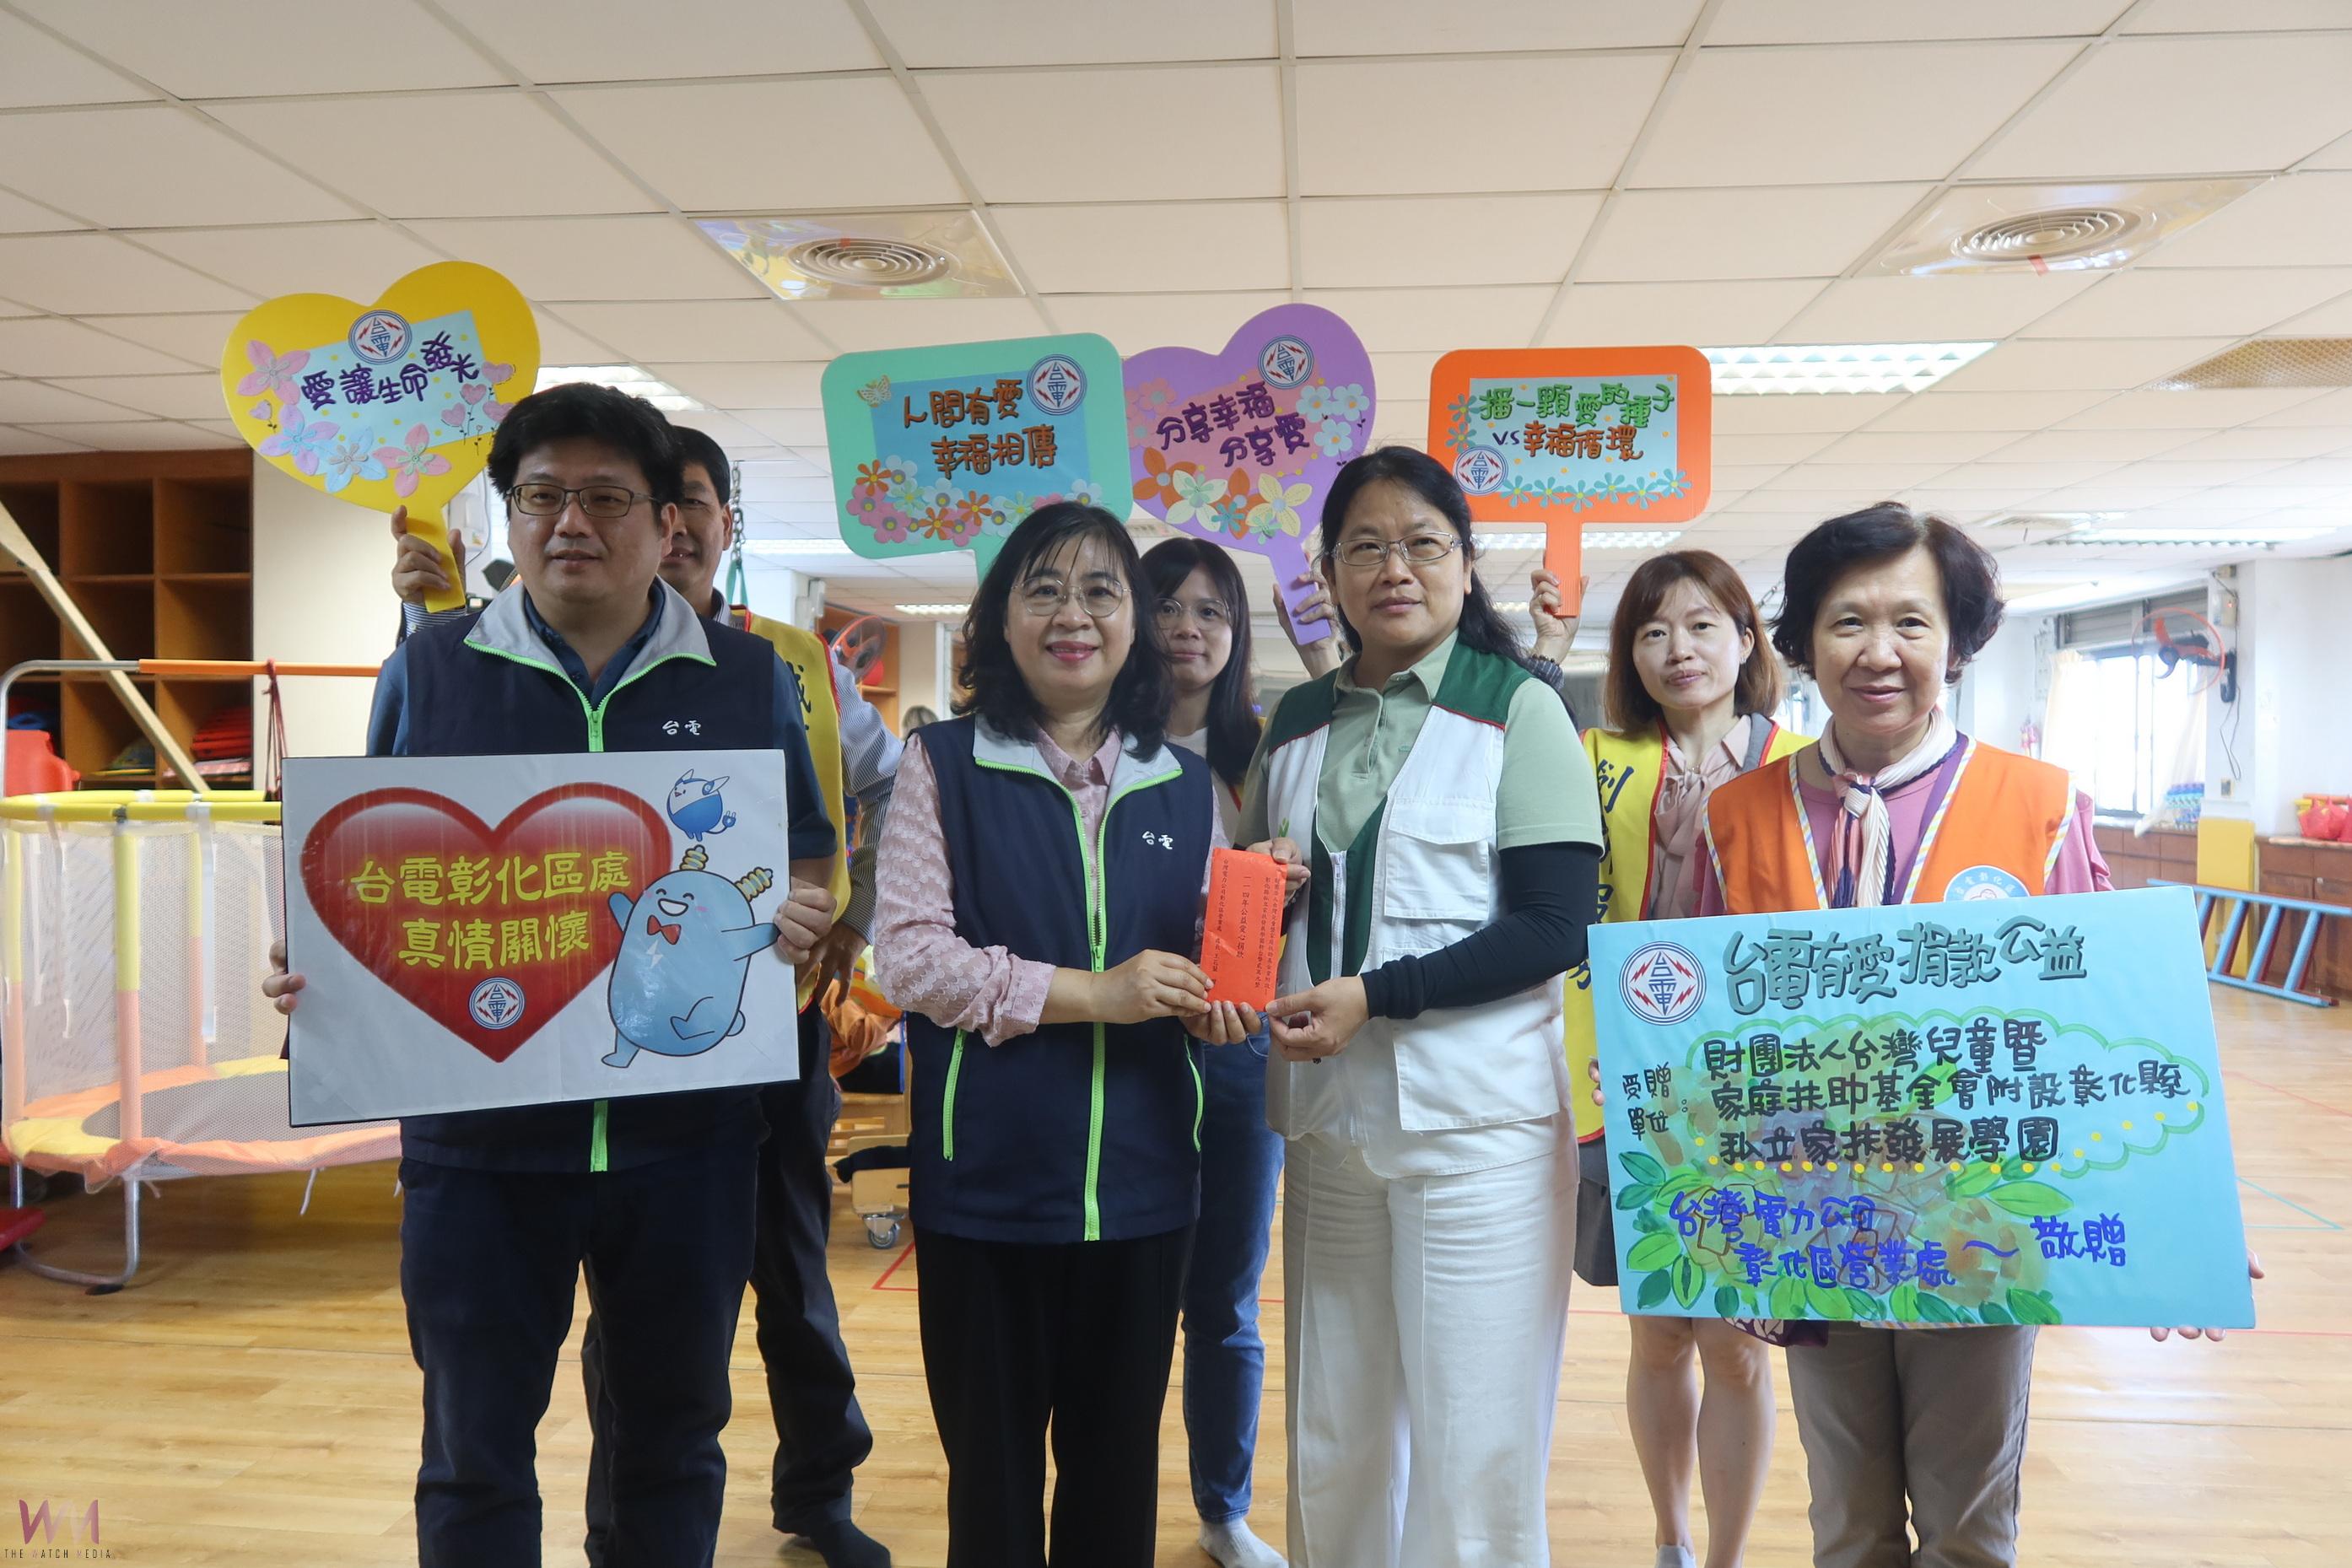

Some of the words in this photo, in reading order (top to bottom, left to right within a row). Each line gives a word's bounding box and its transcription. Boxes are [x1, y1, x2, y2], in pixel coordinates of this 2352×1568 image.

[301, 330, 479, 411] 愛讓生命發光
[904, 379, 1023, 428] 人間有愛
[1157, 380, 1276, 450] 分享幸福
[1479, 383, 1675, 428] 播一顆愛的種子
[931, 424, 1058, 479] 幸福相傳
[1220, 412, 1309, 467] 分享愛
[1524, 420, 1643, 461] 幸福循環
[350, 850, 632, 906] 台電彰化區處
[398, 910, 591, 970] 真情關懷
[1704, 1016, 2047, 1080] 財團法人台灣兒童暨
[1711, 1059, 2191, 1121] 家庭扶助基金會附設彰化縣
[1720, 1116, 2059, 1165] 私立家扶發展學園
[1669, 1188, 1875, 1243] 台灣電力公司
